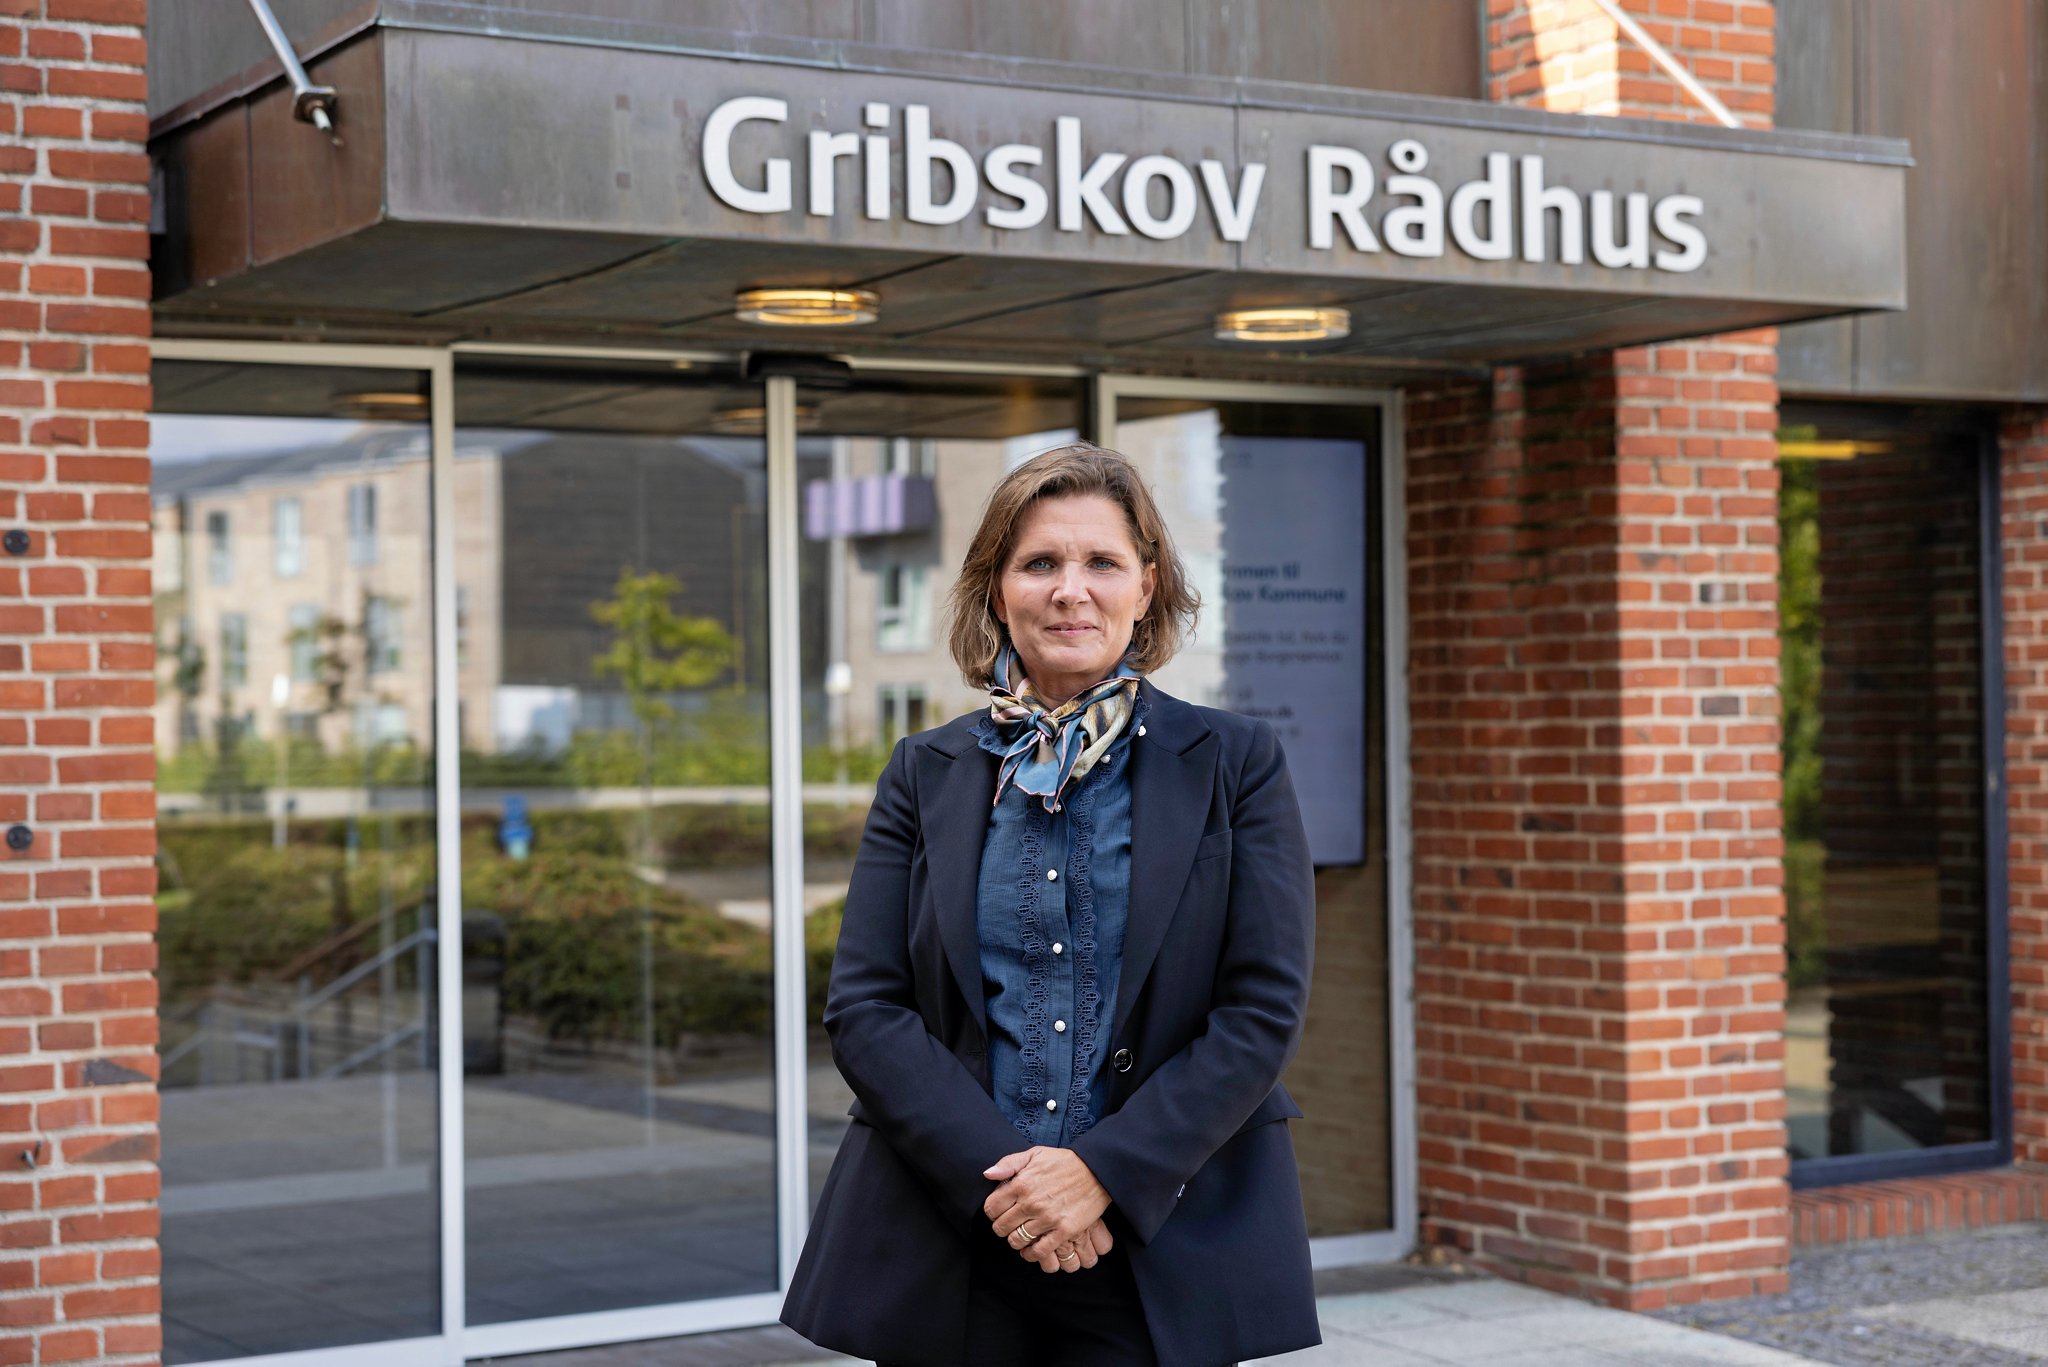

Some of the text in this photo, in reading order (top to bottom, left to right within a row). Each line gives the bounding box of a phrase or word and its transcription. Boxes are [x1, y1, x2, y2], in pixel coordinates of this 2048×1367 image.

[702, 96, 1708, 273] Gribskov Rådhus
[1257, 584, 1347, 602] Kommune
